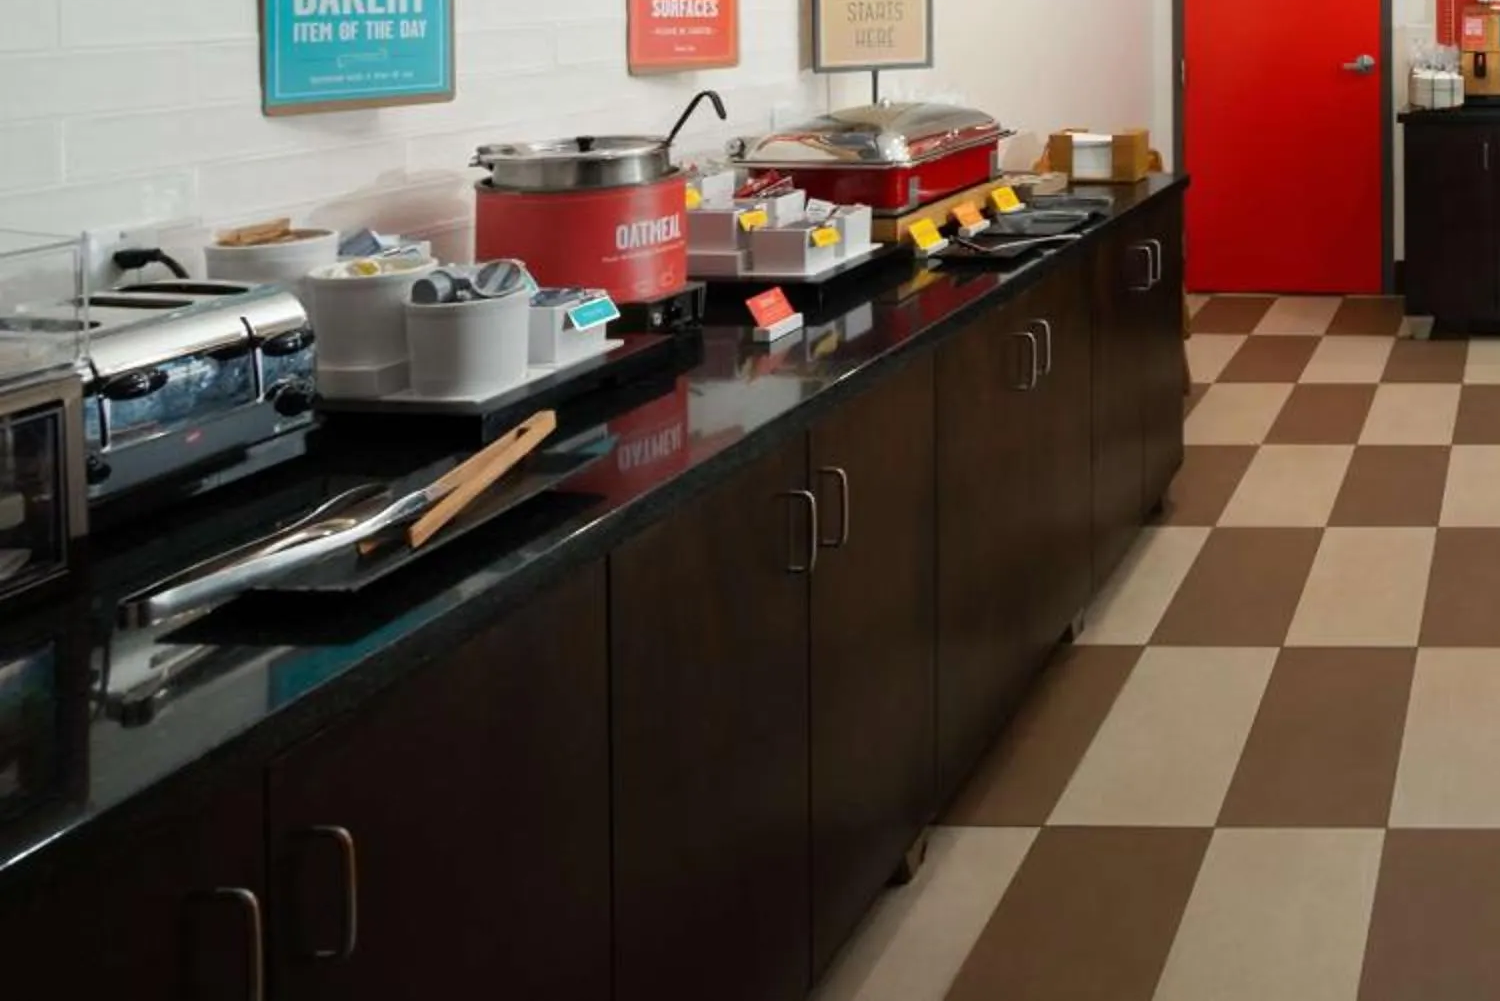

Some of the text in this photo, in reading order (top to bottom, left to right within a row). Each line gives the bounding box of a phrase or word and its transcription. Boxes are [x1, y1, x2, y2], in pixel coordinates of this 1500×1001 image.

[847, 0, 904, 23] STARTS
[292, 19, 428, 44] ITEM OF THE DAY
[854, 25, 896, 48] HERE
